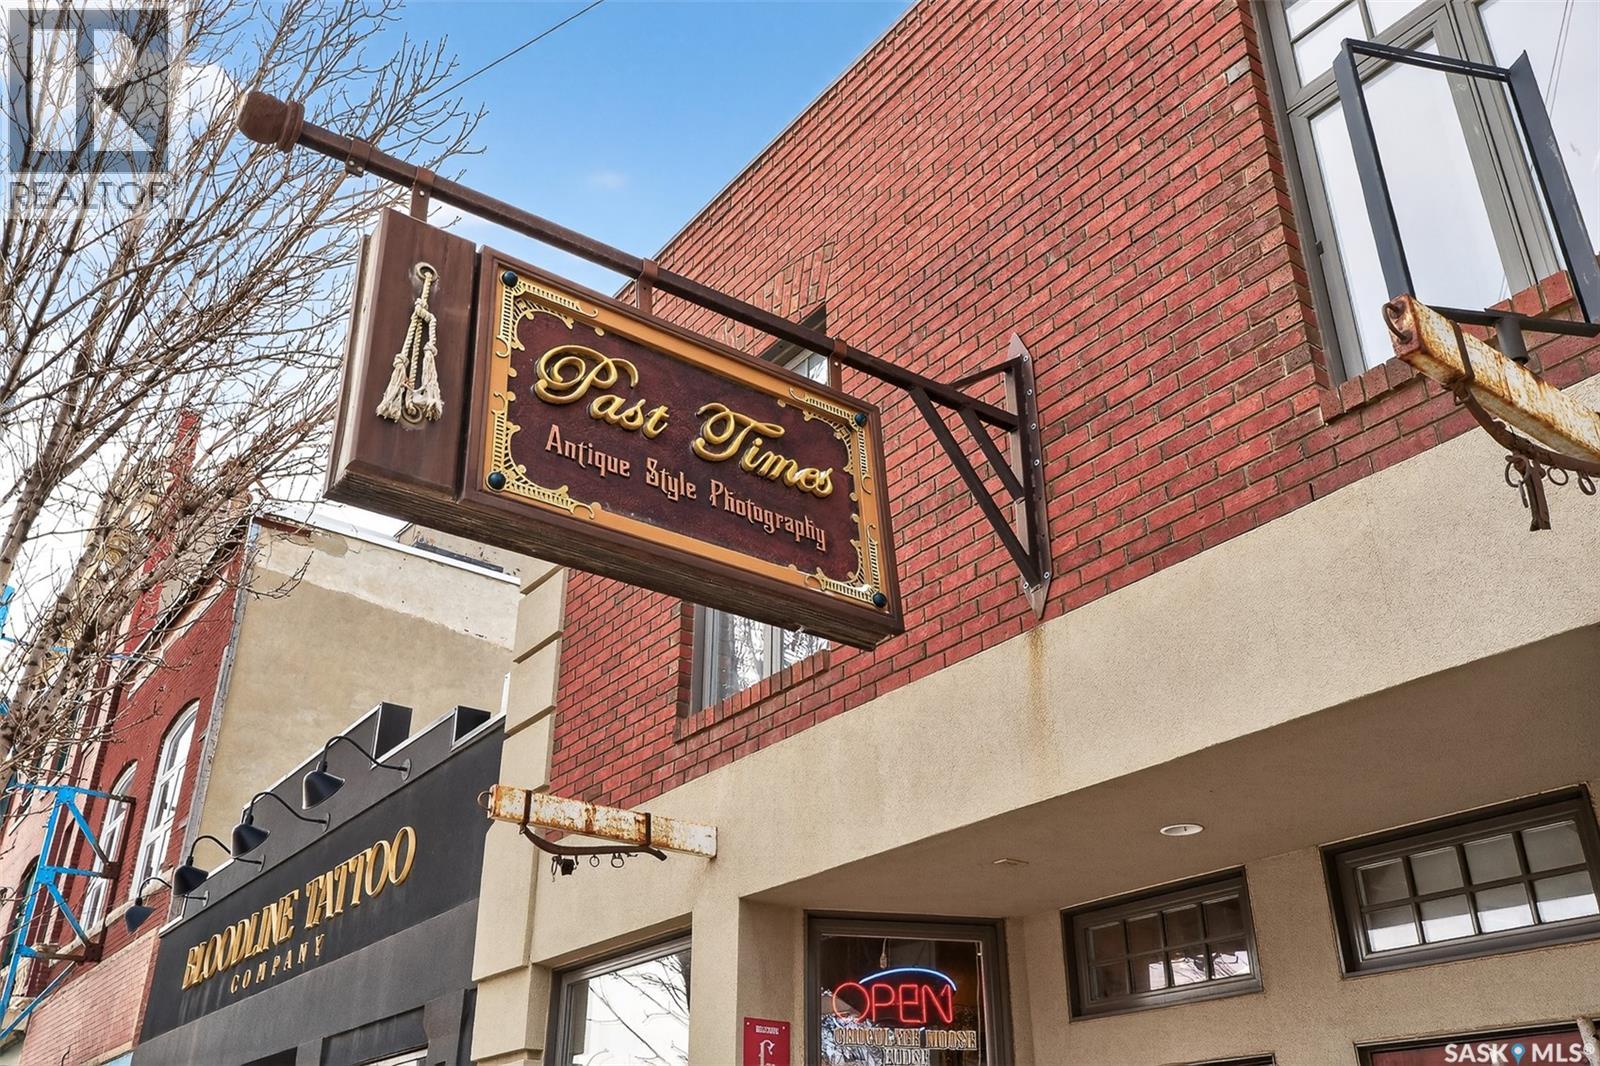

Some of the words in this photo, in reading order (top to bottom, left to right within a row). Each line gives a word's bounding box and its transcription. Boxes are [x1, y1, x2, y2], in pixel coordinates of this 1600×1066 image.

[531, 344, 669, 439] Past
[691, 402, 834, 499] Times
[545, 424, 631, 480] Antique
[645, 457, 697, 502] Style
[709, 479, 828, 552] Photography
[182, 889, 300, 991] BLOODLINE
[304, 826, 417, 930] TATTOO
[230, 934, 325, 994] COMPANY
[832, 982, 952, 1024] OPEN
[925, 1029, 977, 1049] MOOSE
